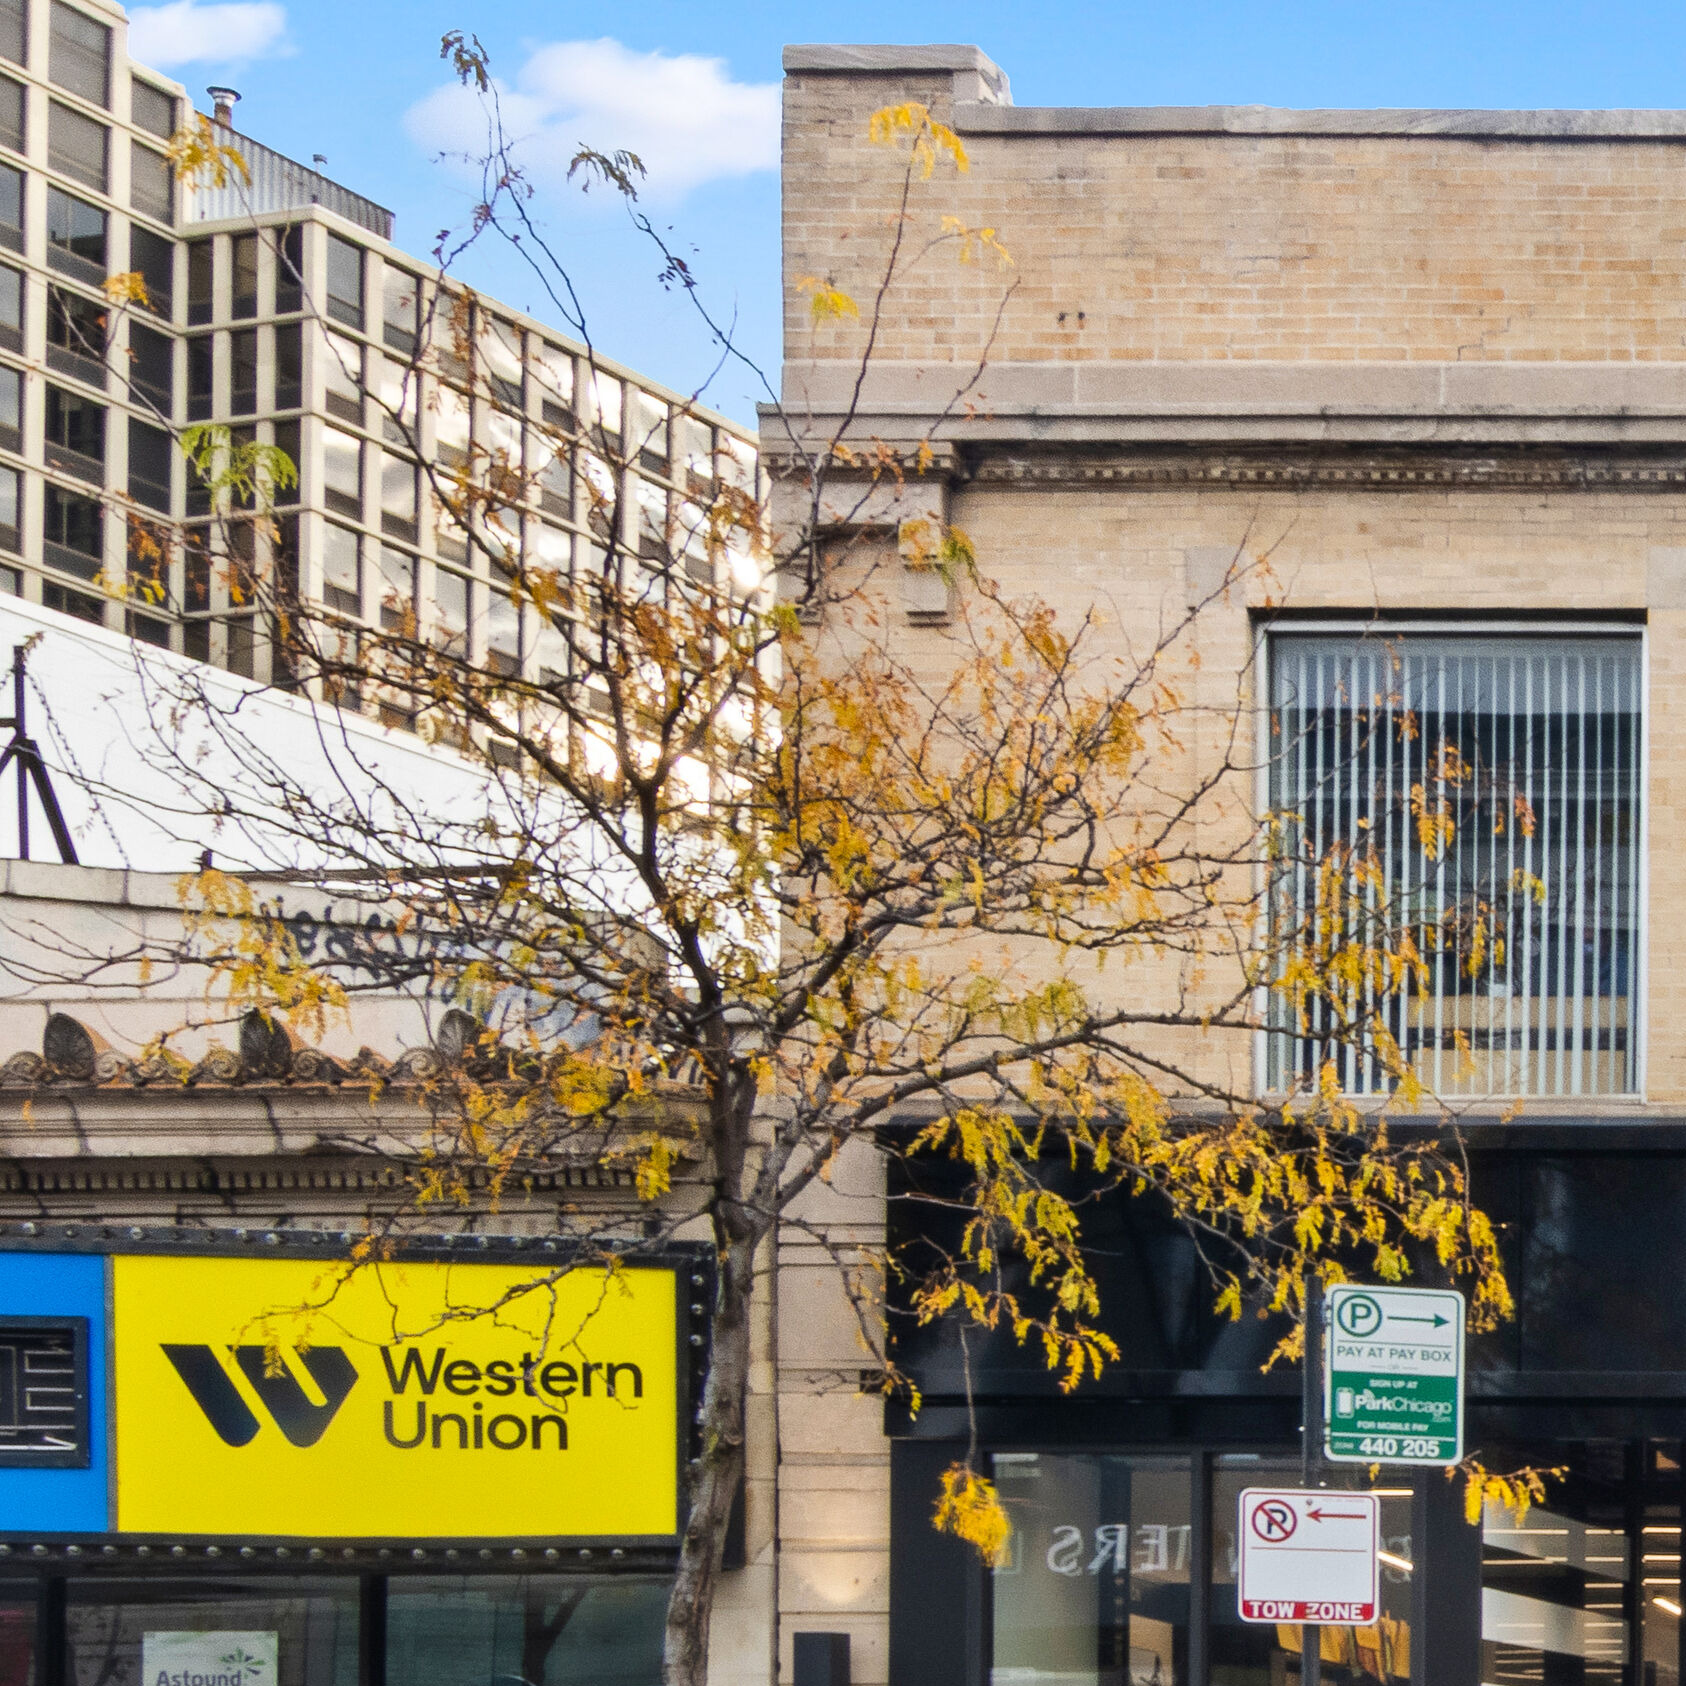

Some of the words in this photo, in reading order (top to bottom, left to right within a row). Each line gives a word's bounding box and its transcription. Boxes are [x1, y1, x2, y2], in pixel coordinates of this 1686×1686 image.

[1337, 1345, 1363, 1357] PAY
[1367, 1347, 1384, 1359] AT
[1390, 1348, 1416, 1360] PAY
[1421, 1350, 1451, 1362] BOX
[380, 1346, 643, 1397] Western
[1392, 1380, 1405, 1389] UP
[1406, 1380, 1418, 1389] AT
[383, 1400, 568, 1450] Union
[1359, 1438, 1398, 1456] 440
[1402, 1440, 1440, 1457] 205
[1250, 1602, 1295, 1619] TOW
[1306, 1602, 1364, 1620] ZONE
